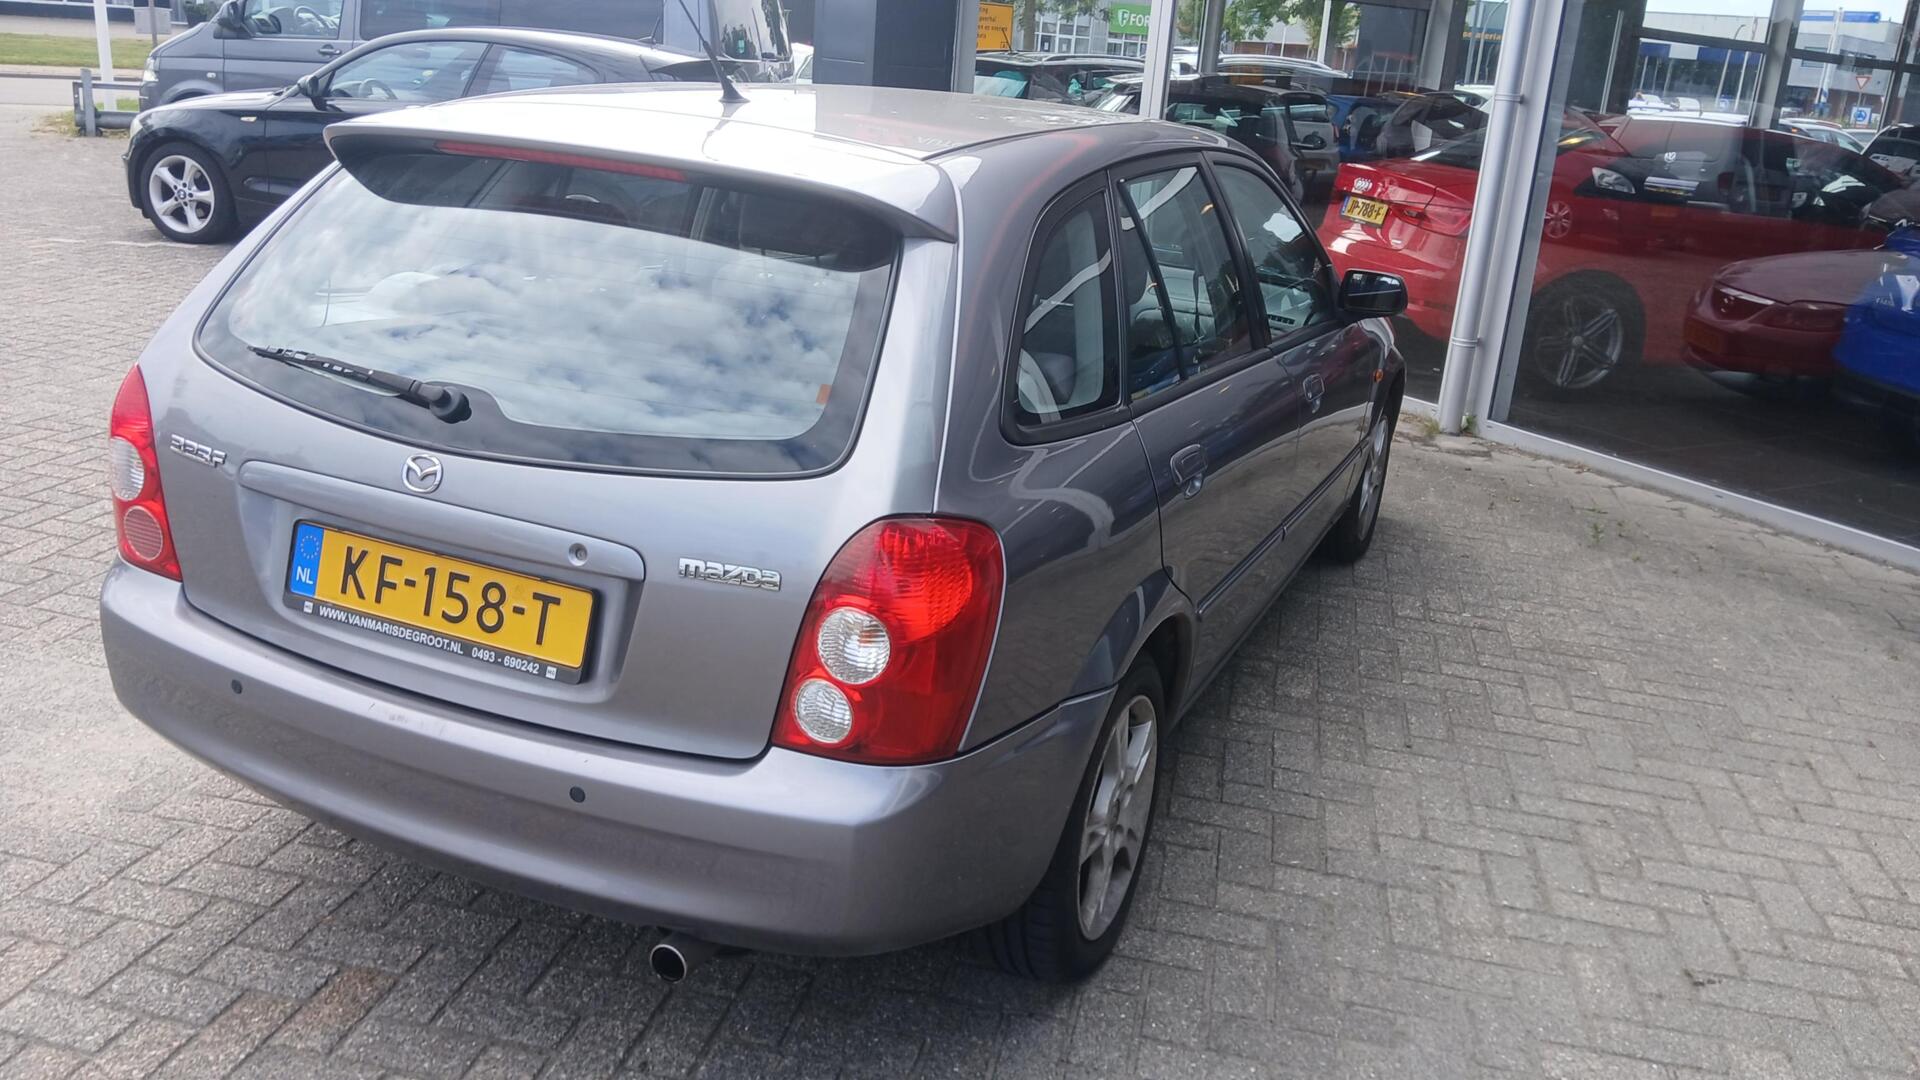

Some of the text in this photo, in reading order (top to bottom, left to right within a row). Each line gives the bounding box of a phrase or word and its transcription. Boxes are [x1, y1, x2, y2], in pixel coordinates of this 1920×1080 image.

[296, 565, 314, 585] NL
[340, 545, 561, 646] KF-158-T
[319, 605, 464, 654] WWW.VANMARISDEGROOT.NL
[472, 647, 495, 663] 0493
[504, 655, 540, 674] 690242
